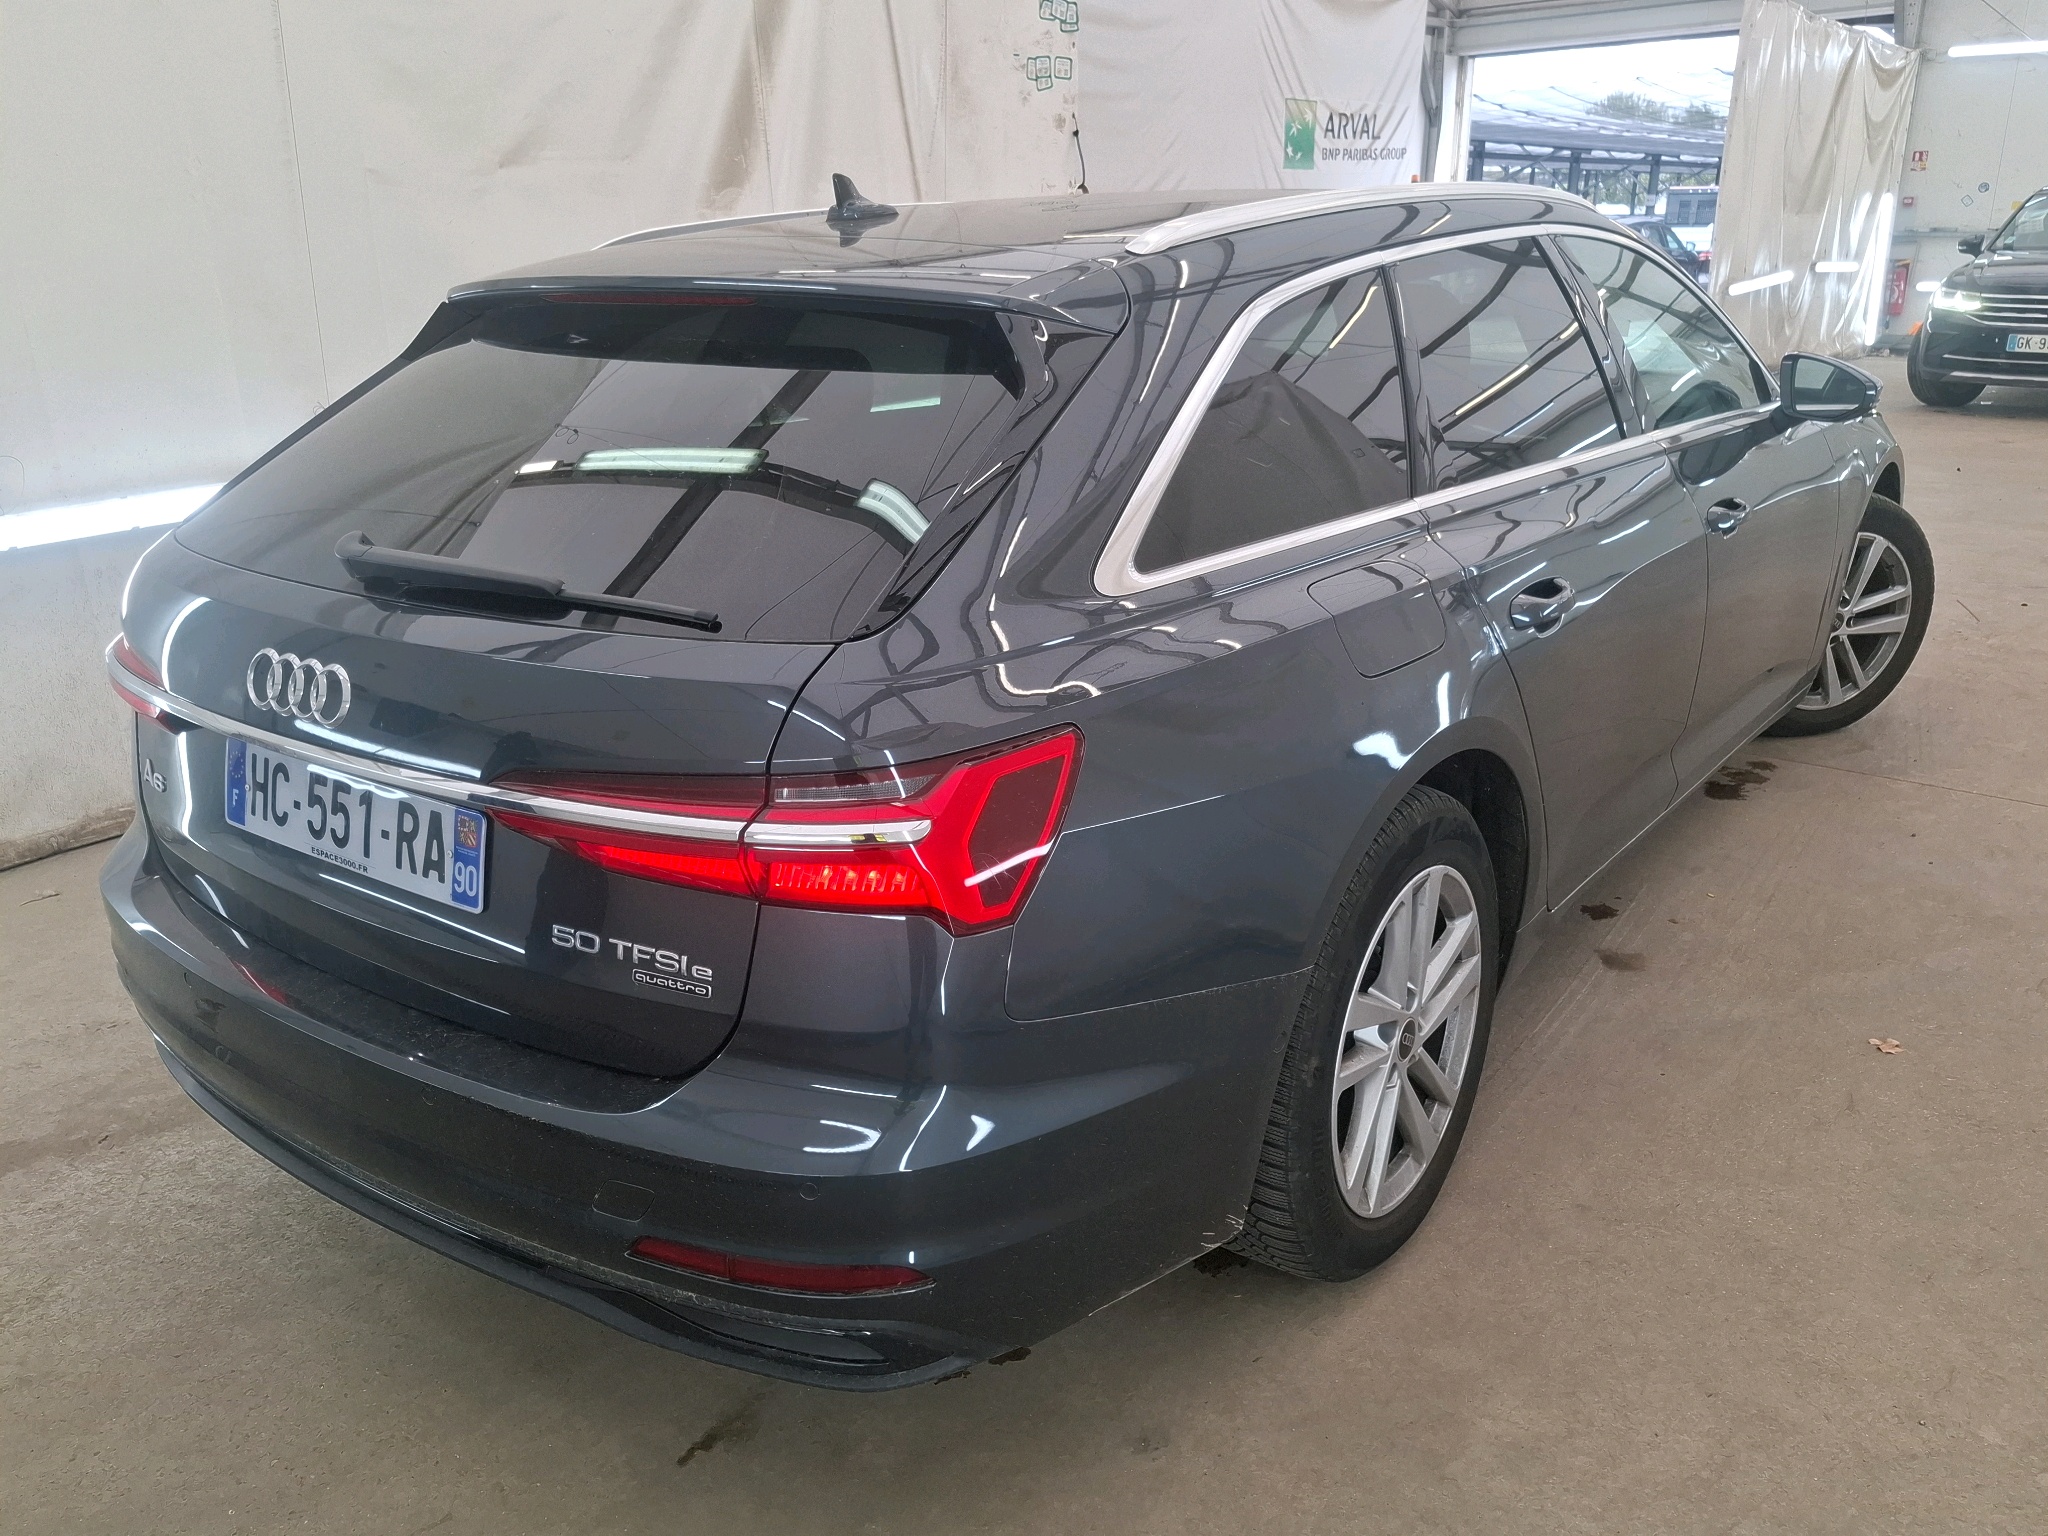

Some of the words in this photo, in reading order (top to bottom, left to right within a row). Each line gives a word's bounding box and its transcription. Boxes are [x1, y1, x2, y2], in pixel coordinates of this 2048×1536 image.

[1324, 112, 1380, 139] ARVAL
[1322, 148, 1340, 160] BNP
[1343, 148, 1378, 161] PARIBAS
[1380, 147, 1407, 160] GROUP
[2017, 336, 2048, 350] GK-9
[144, 758, 167, 792] A6
[232, 788, 239, 807] F
[251, 753, 446, 884] HC-551-RA
[311, 846, 369, 874] ESPACE3000.FR
[454, 861, 477, 897] 90
[552, 924, 600, 954] 50
[635, 973, 707, 995] quattro
